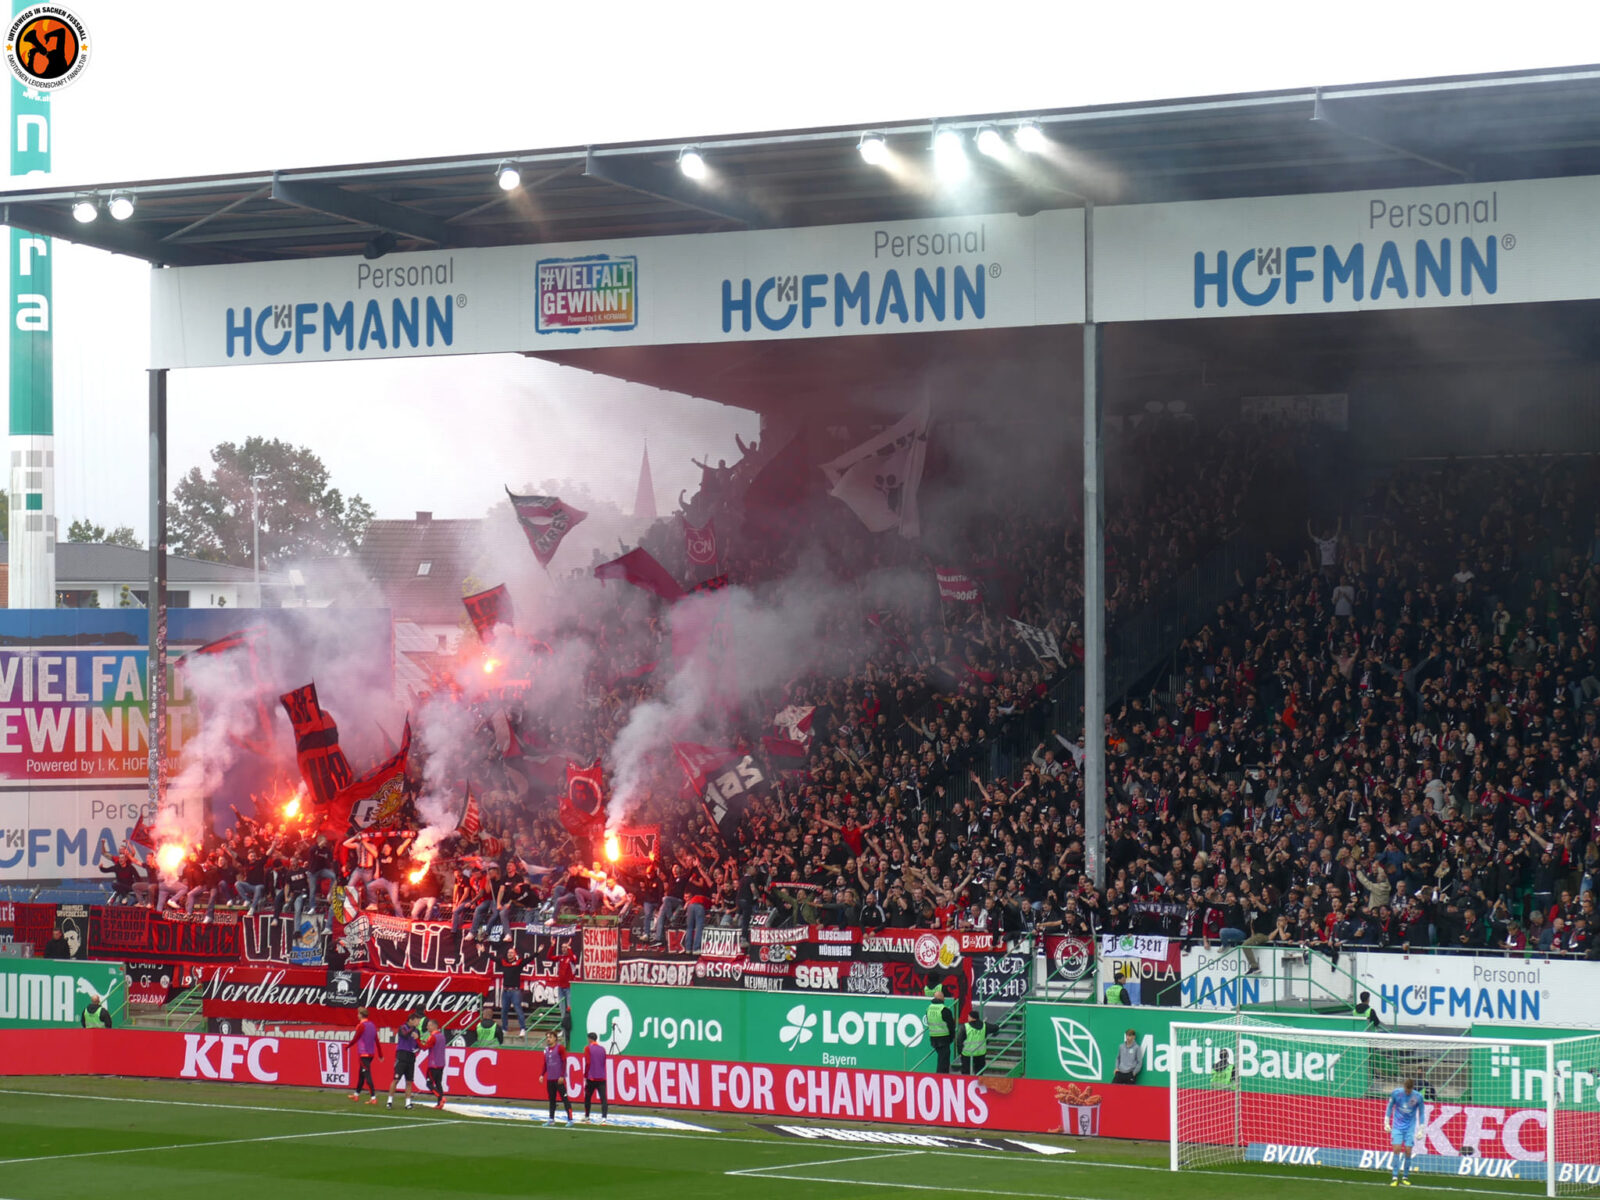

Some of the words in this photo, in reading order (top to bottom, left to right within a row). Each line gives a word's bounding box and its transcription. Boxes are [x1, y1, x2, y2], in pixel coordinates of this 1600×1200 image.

[1370, 191, 1497, 229] Personal
[874, 224, 985, 258] Personal
[357, 257, 454, 290] Personal
[542, 264, 632, 291] #VIELFALT
[1194, 234, 1497, 308] HOFMANN
[543, 288, 630, 315] GEWINNT
[722, 264, 985, 333] HOFMANN
[225, 294, 454, 358] HOFMANN
[26, 758, 77, 773] Powered
[81, 757, 95, 774] by
[583, 929, 618, 946] SEKTION
[583, 947, 618, 963] STADION
[921, 945, 937, 961] FCN
[1198, 955, 1259, 973] Personl
[140, 974, 152, 989] OF
[584, 964, 617, 980] VERBOT
[619, 962, 695, 986] ADELSDORF
[706, 961, 731, 978] RSR
[795, 965, 839, 989] SGN
[1113, 960, 1176, 982] PINOLA
[1474, 965, 1541, 984] Personal
[202, 965, 327, 1007] Nordkurve
[358, 974, 482, 1026] Nürnberg
[744, 975, 784, 991] NEUMARKT
[1381, 984, 1540, 1021] HOFMANN
[639, 1016, 723, 1049] signia
[822, 1009, 924, 1048] LOTTO
[180, 1034, 280, 1082] KFC
[822, 1052, 857, 1067] Bayern
[326, 1073, 345, 1083] KFC
[565, 1056, 700, 1106] CICKEN
[711, 1064, 775, 1111] FOR
[785, 1068, 989, 1125] CHAMPIONS
[1412, 1103, 1547, 1162] KFC
